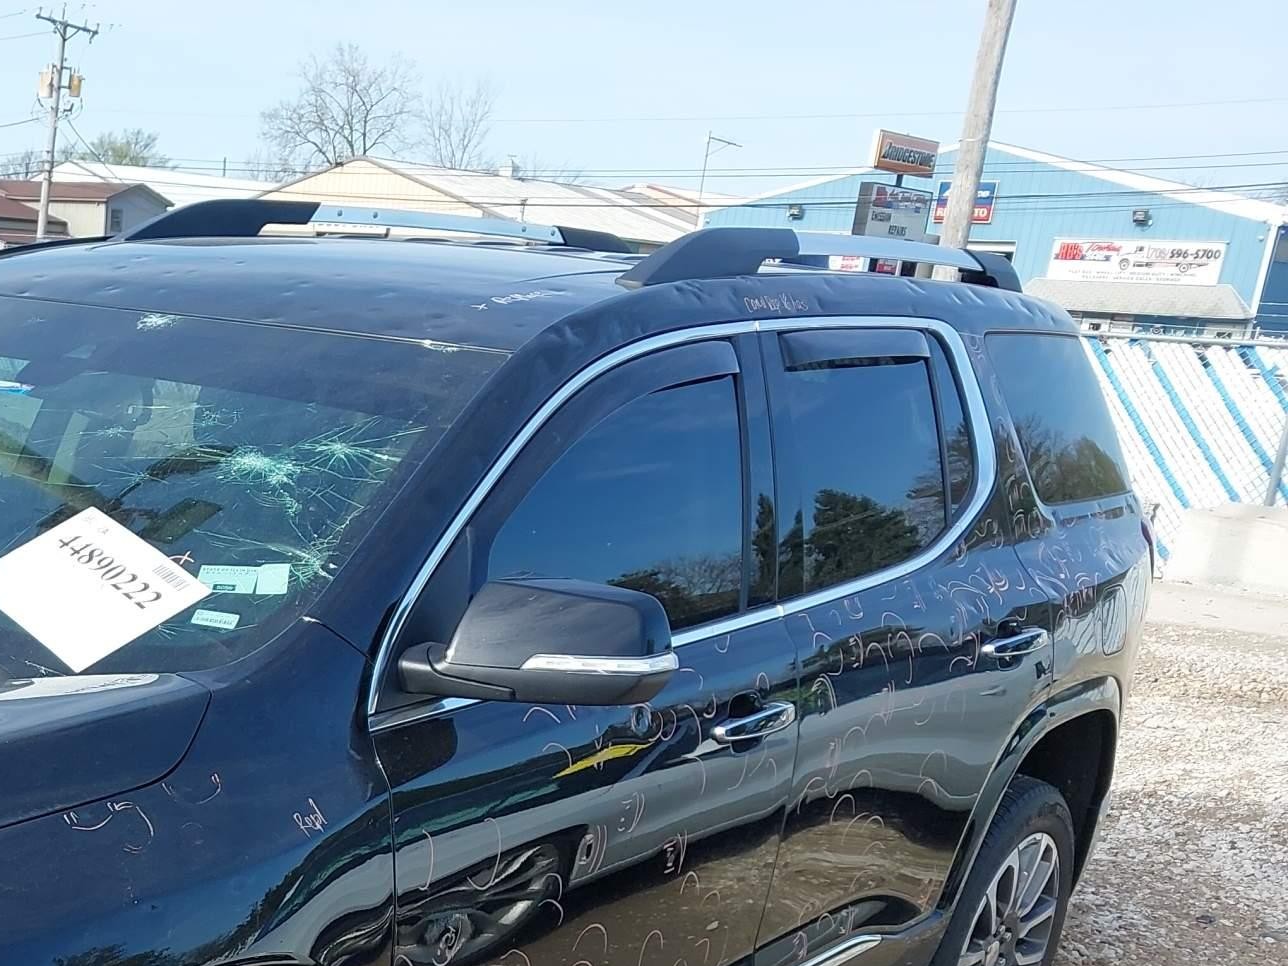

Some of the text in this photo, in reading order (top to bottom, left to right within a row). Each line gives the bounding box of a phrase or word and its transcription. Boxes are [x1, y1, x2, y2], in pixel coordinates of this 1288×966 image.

[881, 141, 936, 168] BRIDGESTONE
[1169, 248, 1222, 261] 596-5700
[58, 535, 163, 610] 44890222
